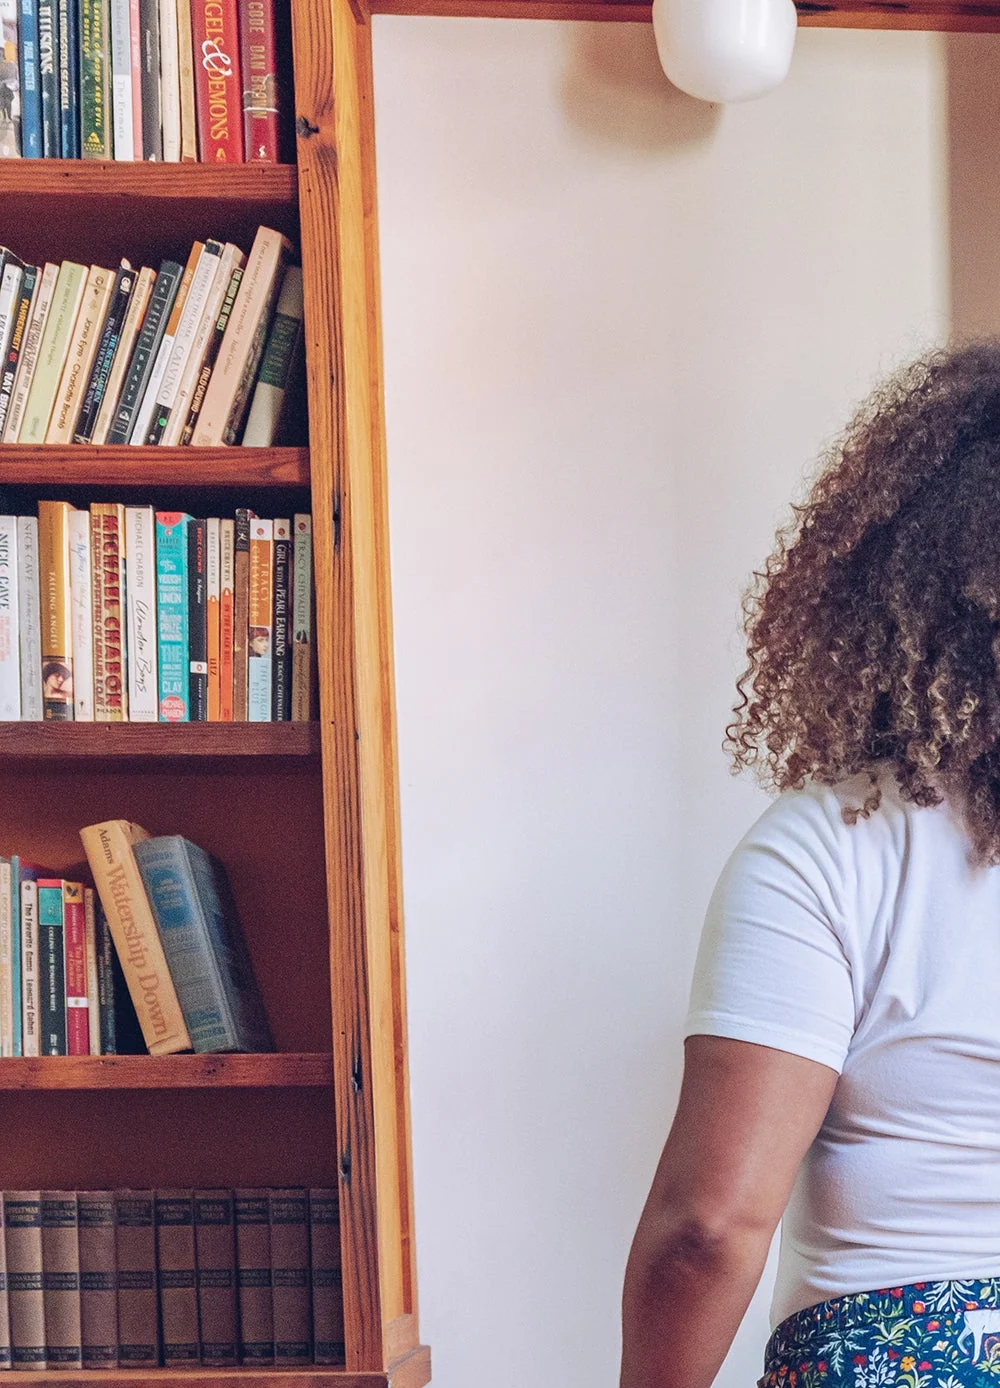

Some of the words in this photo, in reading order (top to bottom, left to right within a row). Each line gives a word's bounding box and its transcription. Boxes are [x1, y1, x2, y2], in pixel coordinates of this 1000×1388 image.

[248, 3, 264, 33] CODE
[24, 41, 34, 60] PAUL
[39, 6, 53, 75] ILLUSIONS
[249, 46, 266, 70] DAN
[25, 61, 35, 91] AUSTER
[250, 75, 267, 119] BROWN
[12, 298, 30, 352] FAHRENHEIT
[161, 345, 186, 400] CALVINO
[198, 367, 211, 385] ITALO
[190, 385, 206, 413] CALVINO
[24, 523, 33, 551] NICK
[134, 512, 144, 550] MICHAEL
[24, 555, 33, 583] CAVE
[103, 514, 120, 610] MICHAEL
[135, 552, 145, 588] CHABON
[297, 540, 305, 570] TRACY
[260, 562, 269, 604] TRACY
[297, 572, 306, 625] CHEVALIER
[104, 617, 121, 706] CHABON
[136, 657, 152, 693] Boys
[25, 903, 33, 916] The
[25, 918, 33, 948] Favorite
[98, 828, 116, 864] Adams
[108, 864, 149, 969] Watership
[137, 974, 170, 1036] Down
[26, 979, 35, 1010] Leonard
[27, 1012, 35, 1036] Cohen
